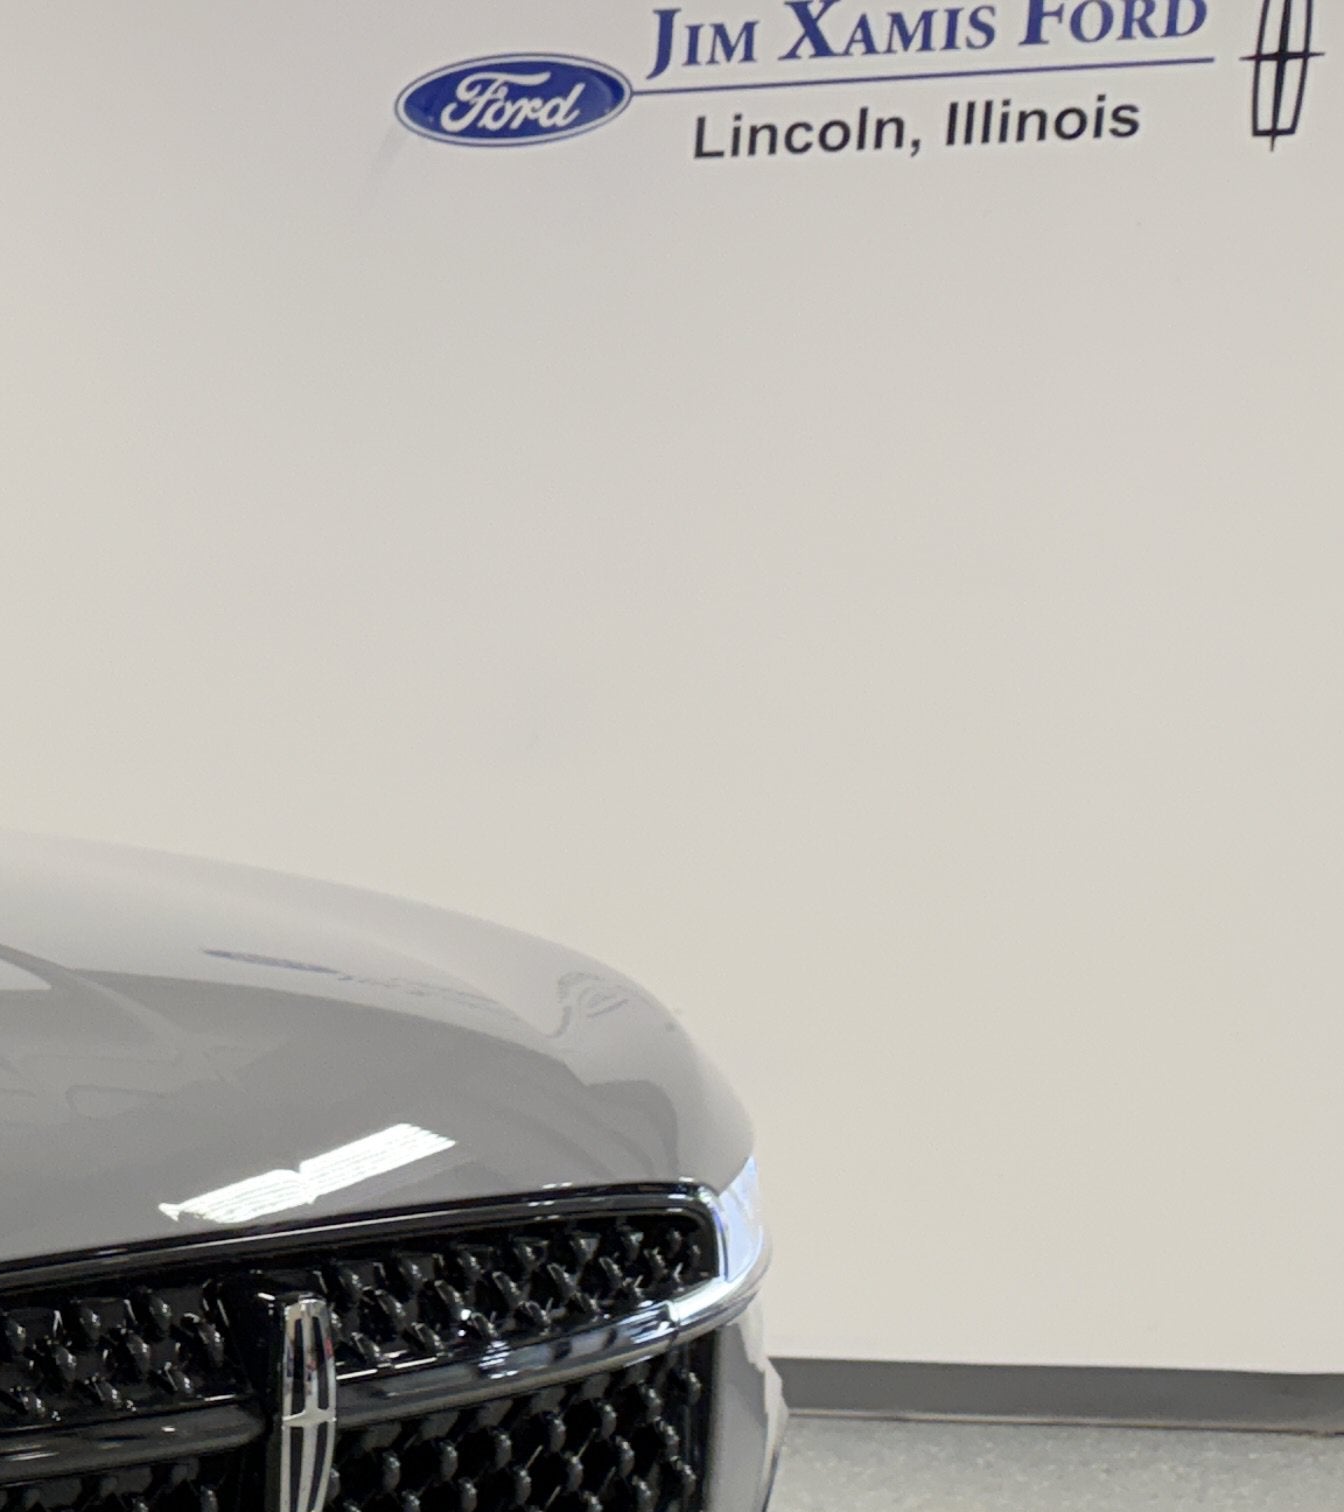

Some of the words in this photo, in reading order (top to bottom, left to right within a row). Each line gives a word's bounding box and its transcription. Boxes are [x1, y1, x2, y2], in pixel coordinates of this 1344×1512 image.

[645, 8, 760, 80] JIM
[777, 0, 997, 61] XAMIS
[1018, 0, 1209, 47] FORD
[440, 71, 587, 133] Ford
[693, 106, 921, 160] Lincoln,
[944, 94, 1141, 147] Illinois
